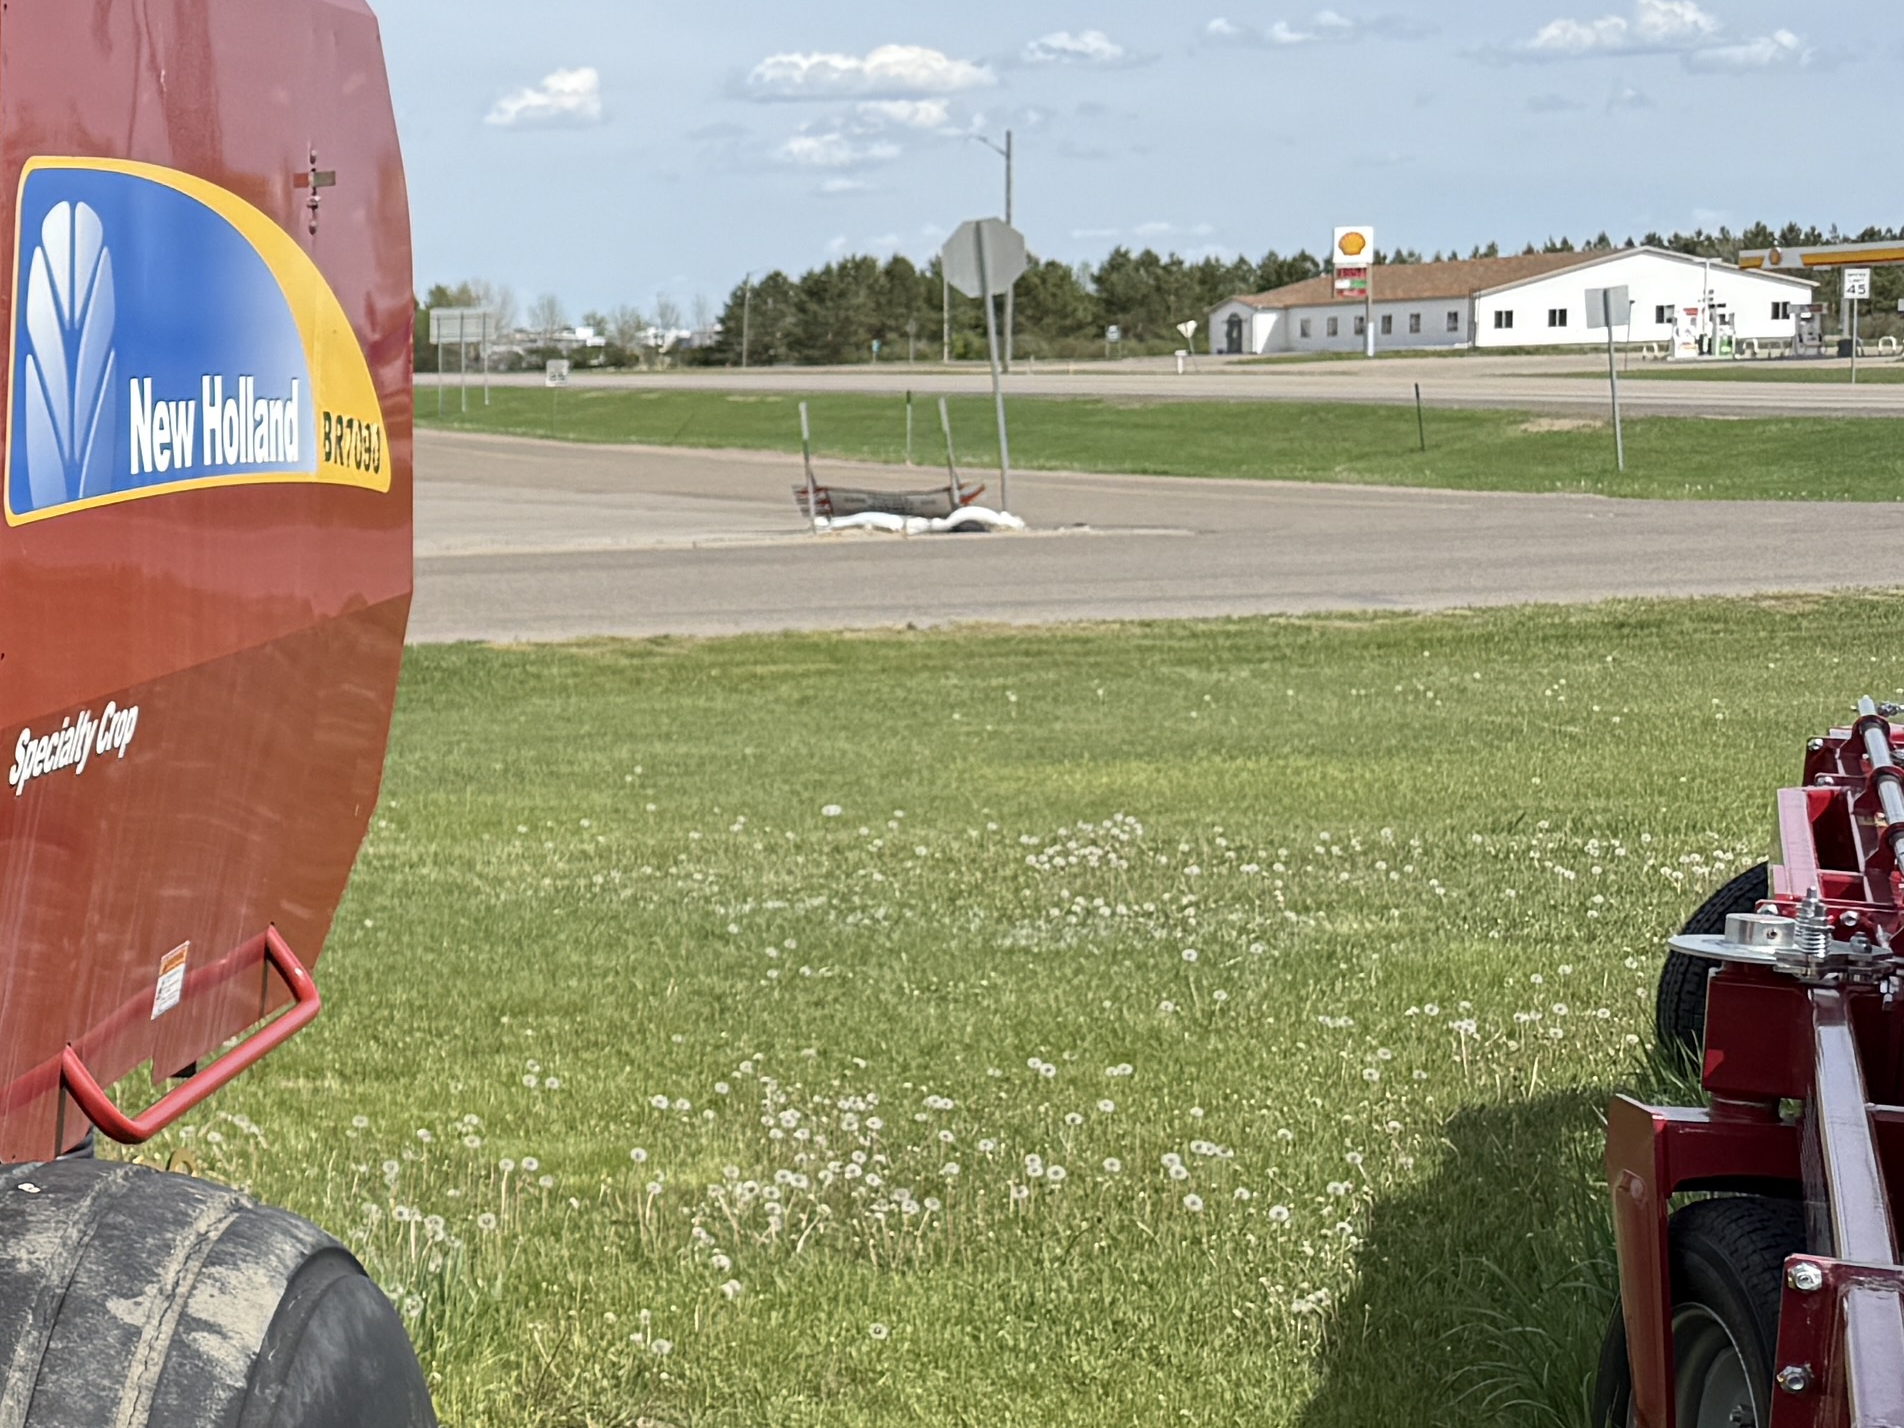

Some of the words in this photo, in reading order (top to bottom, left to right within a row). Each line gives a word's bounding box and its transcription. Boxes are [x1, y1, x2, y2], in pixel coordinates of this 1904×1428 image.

[1847, 284, 1866, 295] 45
[130, 376, 195, 475] New
[202, 374, 299, 465] Holland
[322, 411, 380, 474] BR7090
[9, 709, 99, 797] Specialty
[96, 700, 139, 759] Crop
